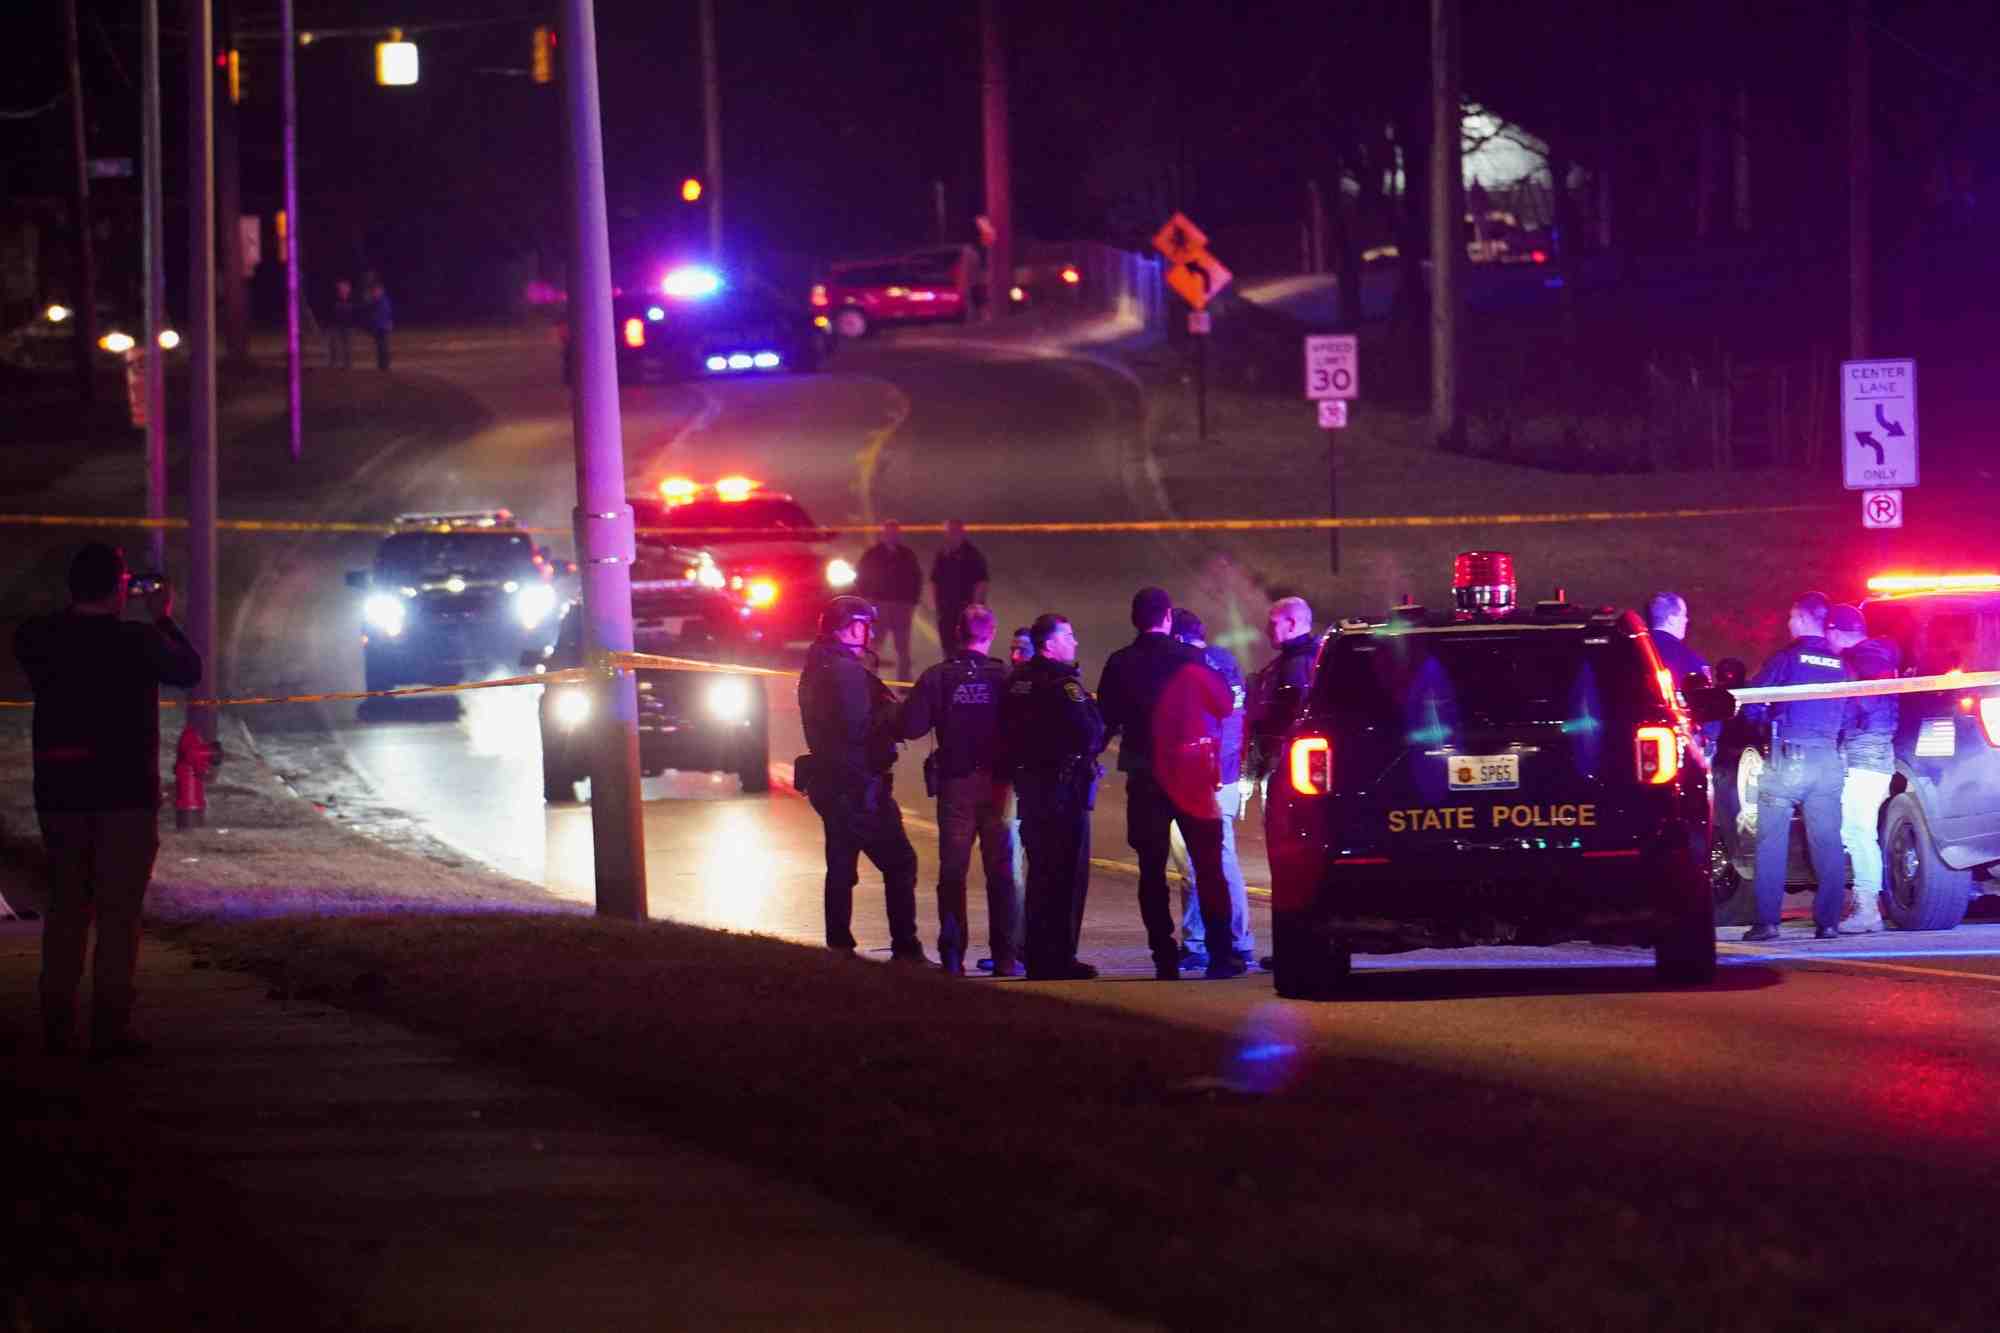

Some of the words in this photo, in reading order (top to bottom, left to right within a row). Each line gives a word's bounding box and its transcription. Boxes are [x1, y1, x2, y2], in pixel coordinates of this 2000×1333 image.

[1851, 367, 1906, 379] CENTER
[1313, 368, 1351, 392] 30
[1859, 382, 1898, 394] LANE
[1863, 469, 1898, 481] ONLY
[1799, 654, 1841, 669] POLICE
[955, 683, 988, 694] ATF
[952, 693, 991, 705] POLICE
[1480, 765, 1512, 782] SP65
[1388, 807, 1476, 832] STATE
[1492, 804, 1597, 828] POLICE
